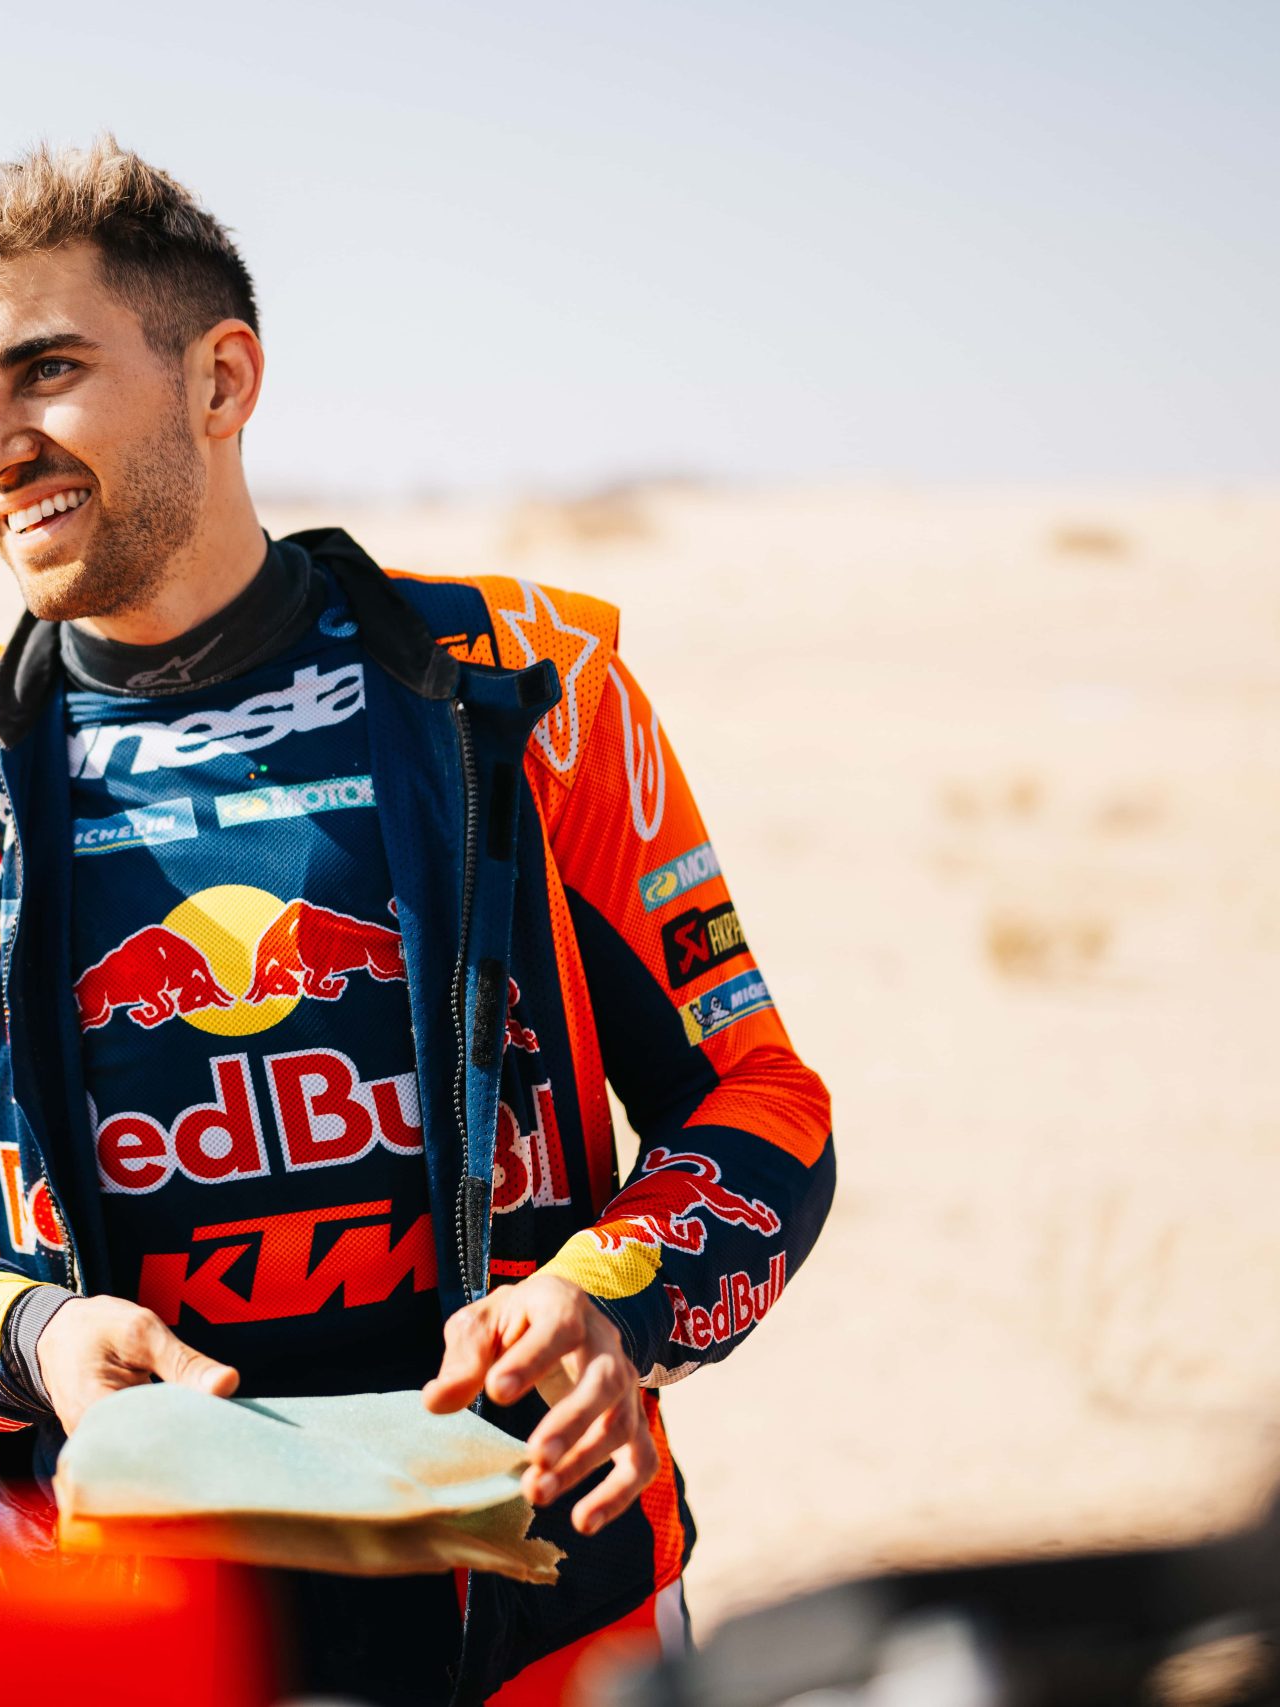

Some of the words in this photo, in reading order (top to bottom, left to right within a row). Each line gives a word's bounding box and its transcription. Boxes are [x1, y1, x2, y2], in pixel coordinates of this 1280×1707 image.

[74, 815, 176, 845] ICHELIN
[87, 1052, 271, 1195] ed
[263, 1048, 424, 1173] Bu
[138, 1198, 439, 1326] KTM
[663, 1273, 732, 1350] Red
[730, 1250, 786, 1335] Bull
